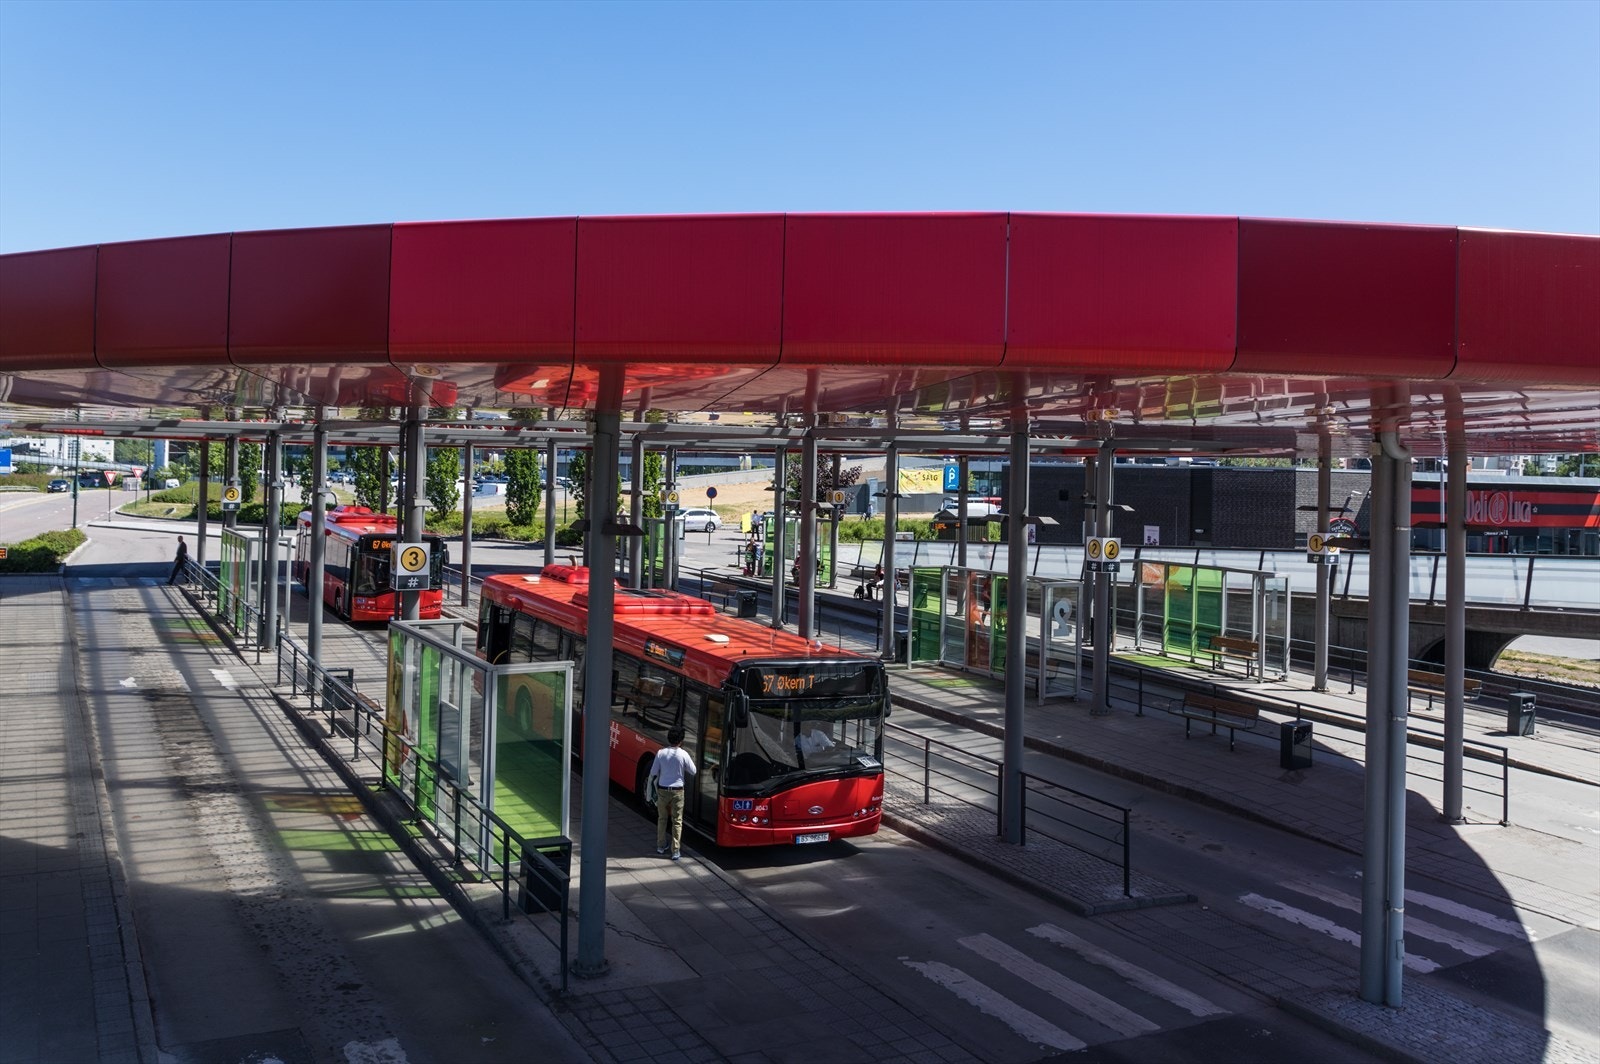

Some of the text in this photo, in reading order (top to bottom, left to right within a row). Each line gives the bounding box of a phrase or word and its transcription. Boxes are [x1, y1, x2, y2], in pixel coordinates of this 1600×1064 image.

[948, 472, 956, 484] P
[229, 490, 235, 498] 3
[1465, 490, 1488, 522] Deli
[1508, 491, 1531, 523] Luca
[1108, 544, 1115, 556] 2
[408, 551, 419, 567] 3
[776, 675, 805, 690] Økern
[808, 674, 815, 689] T
